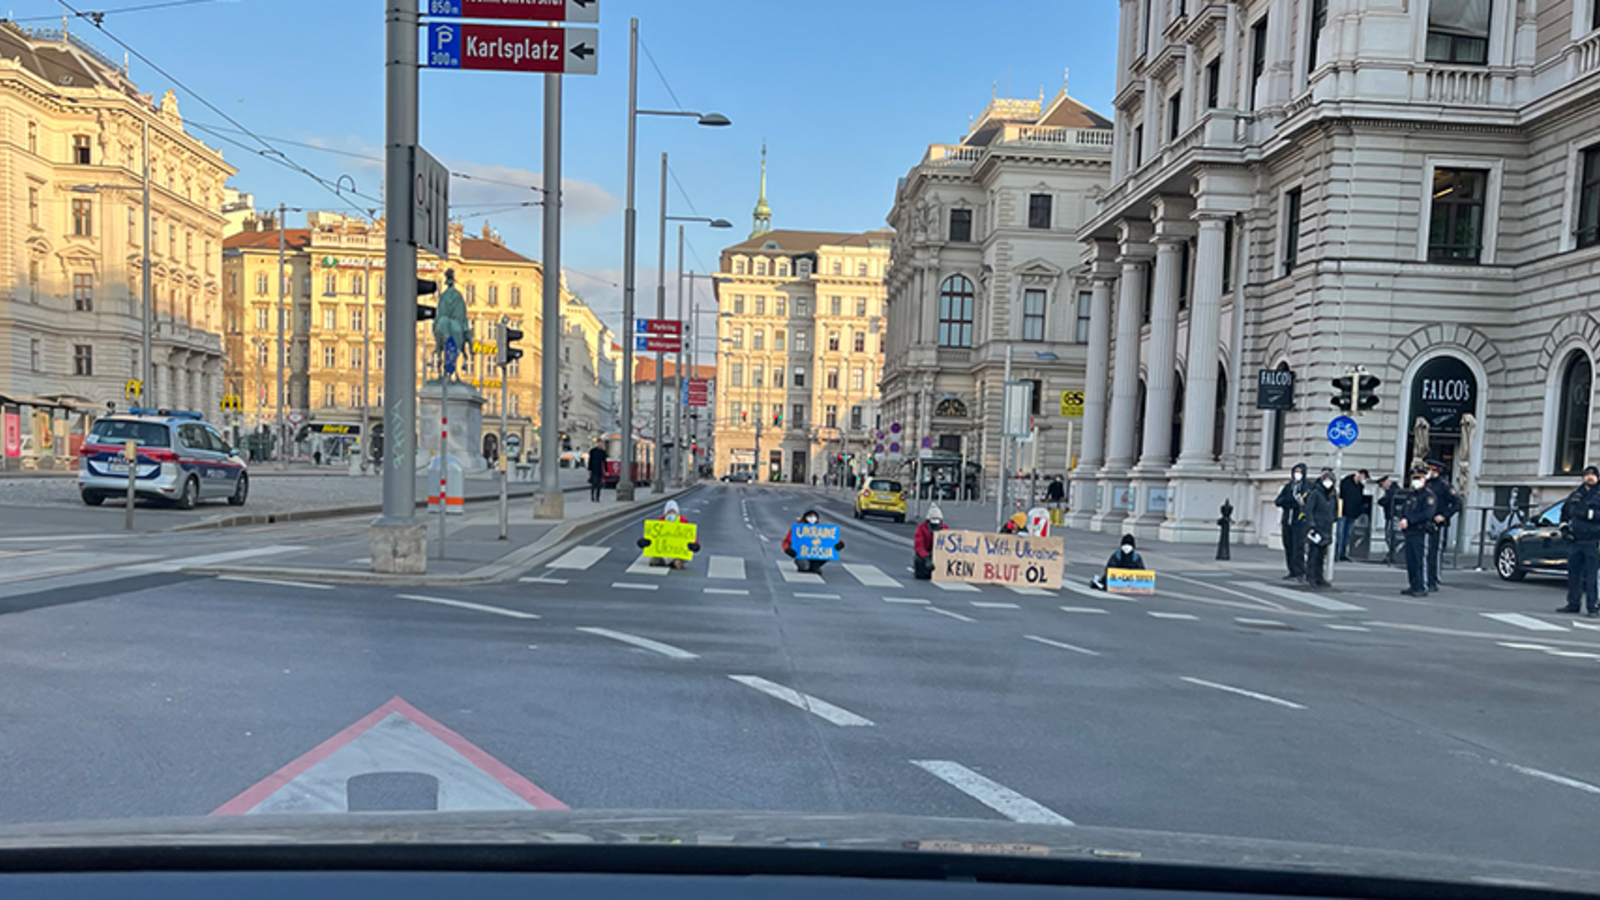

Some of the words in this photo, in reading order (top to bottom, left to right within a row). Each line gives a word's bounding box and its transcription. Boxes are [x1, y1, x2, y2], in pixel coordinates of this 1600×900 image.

[466, 36, 559, 64] Karlsplatz
[1421, 379, 1470, 401] FALCO's
[1014, 540, 1058, 562] Ukraine
[946, 559, 975, 577] KEIN
